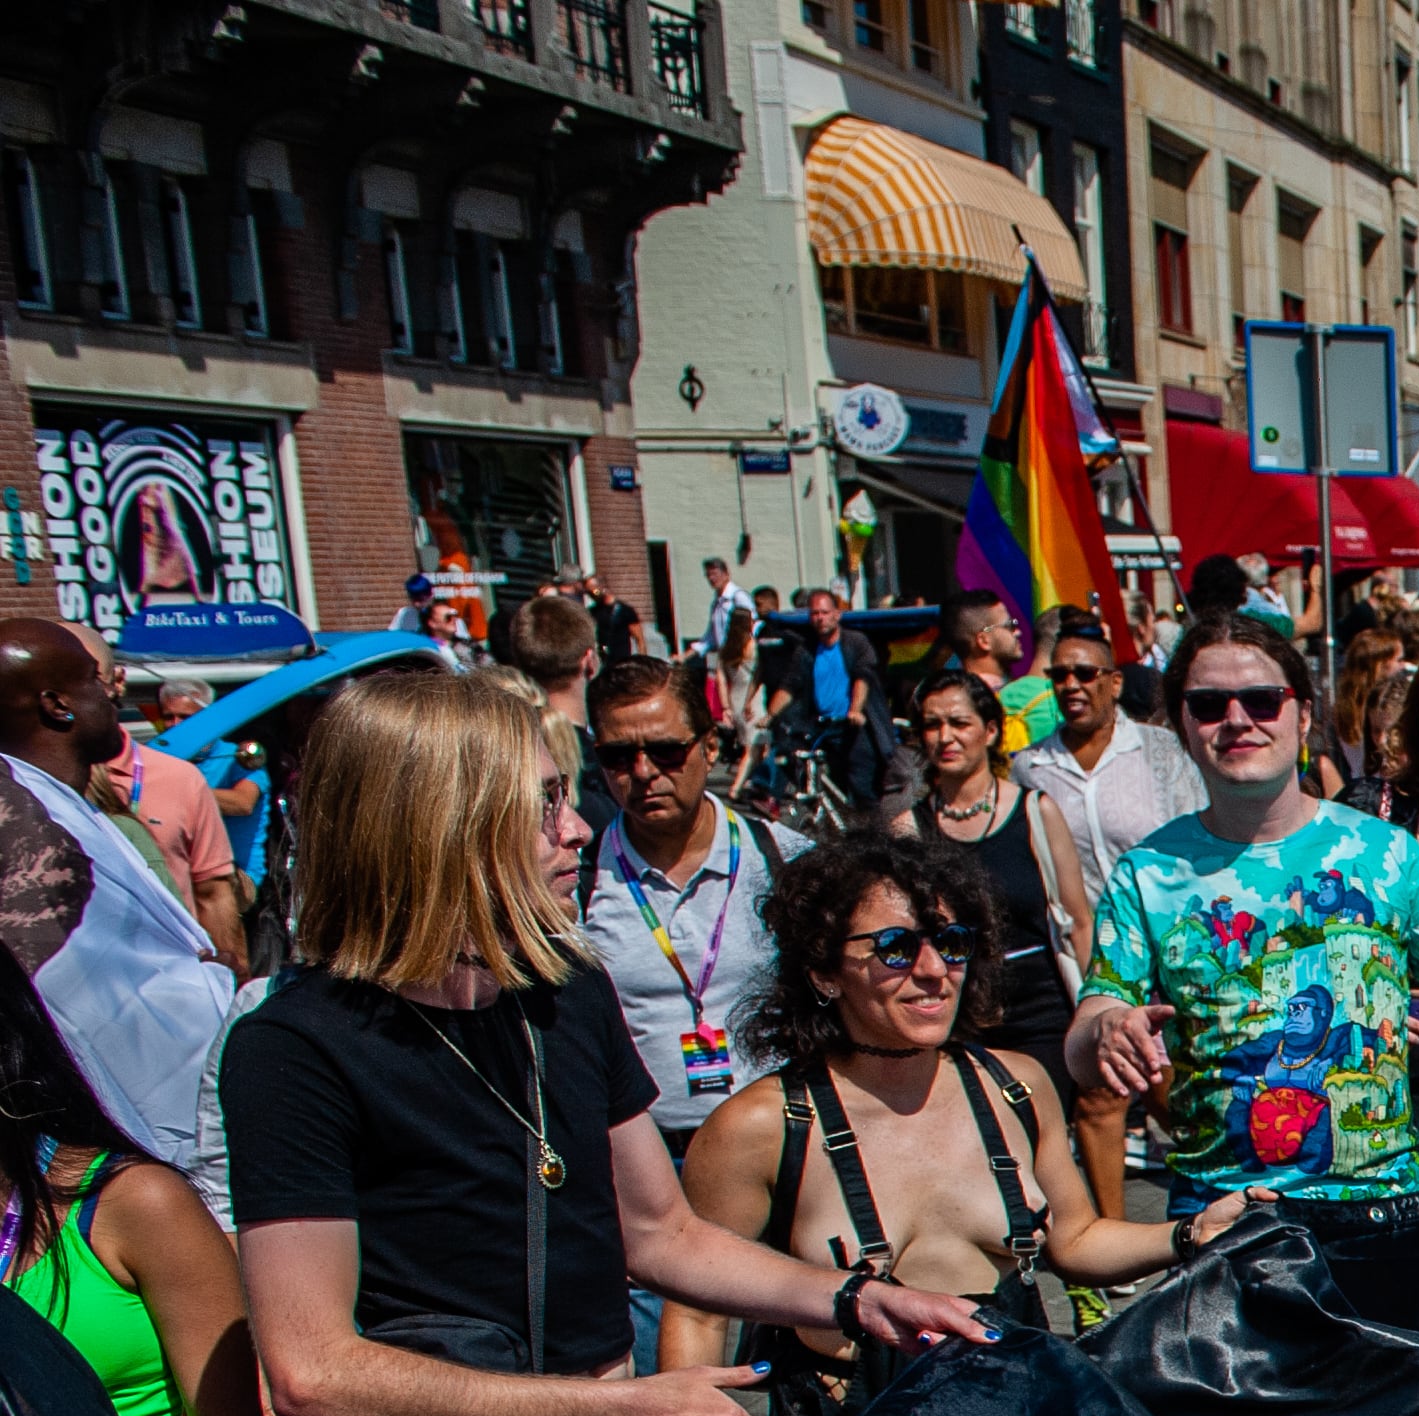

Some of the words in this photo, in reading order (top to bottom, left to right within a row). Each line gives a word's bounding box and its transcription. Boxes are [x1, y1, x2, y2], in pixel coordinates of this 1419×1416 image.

[34, 430, 91, 623] SHION
[70, 429, 117, 583] GOOD
[207, 439, 256, 604] SHION
[239, 441, 285, 603] SEUM
[145, 611, 207, 626] BikeTaxi
[215, 611, 227, 623] &
[234, 611, 276, 623] Tours
